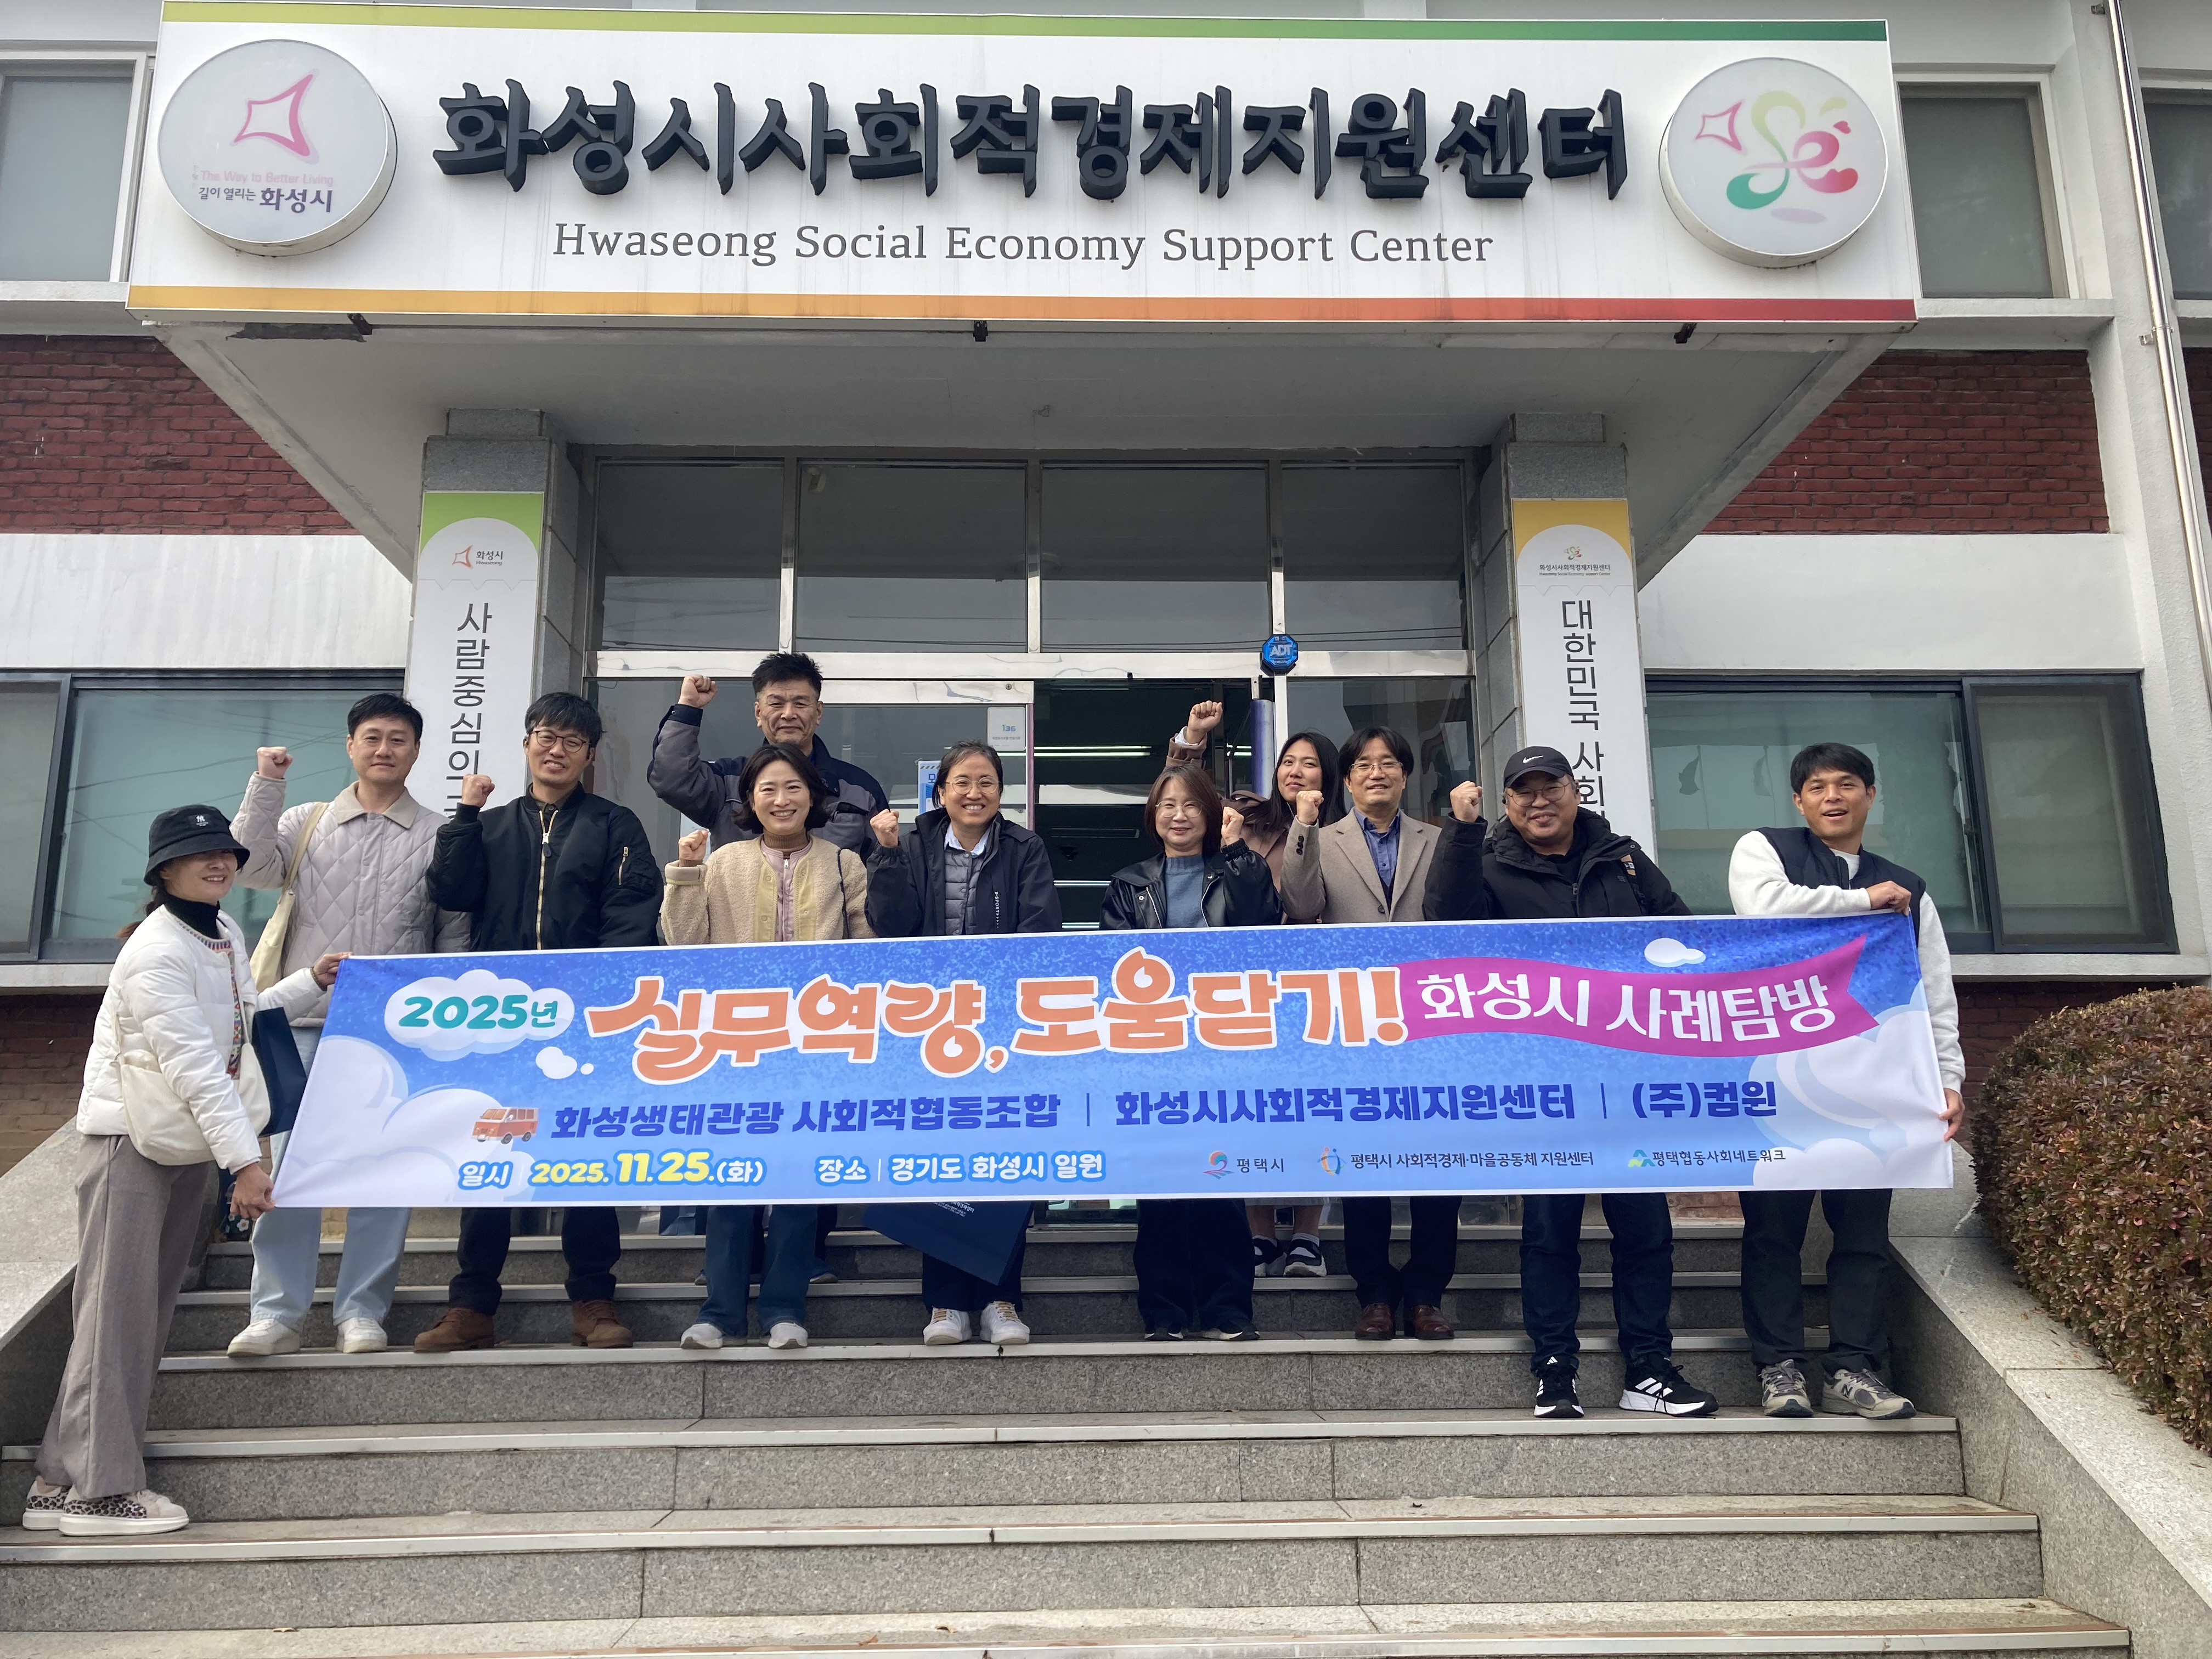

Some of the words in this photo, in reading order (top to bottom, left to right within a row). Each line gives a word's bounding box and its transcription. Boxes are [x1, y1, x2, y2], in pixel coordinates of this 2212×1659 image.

[432, 78, 1628, 200] 화성시사회적경제지원센터
[201, 170, 219, 181] The
[224, 171, 247, 184] Way
[252, 172, 261, 183] to
[266, 172, 300, 184] Better
[303, 173, 334, 187] Living
[199, 187, 220, 200] 길이
[223, 188, 256, 201] 열리는
[259, 188, 332, 213] 화성시
[552, 223, 777, 267] Hwaseong
[794, 224, 927, 261] Social
[946, 227, 1146, 270] Economy
[1163, 228, 1334, 270] Support
[1350, 229, 1493, 263] Center
[476, 551, 504, 561] 화성시
[1269, 644, 1293, 657] ADT
[1561, 600, 1600, 731] 대한민국
[1572, 741, 1605, 819] 사회
[398, 994, 558, 1029] 2025년
[1417, 972, 1590, 1028] 화성시
[1606, 974, 1829, 1043] 사례탐방
[550, 1101, 784, 1138] 화성생태관광
[792, 1093, 1060, 1133] 사회적협동조합
[1115, 1082, 1576, 1126] 화성시사회적경제지원센터
[1632, 1081, 1778, 1119] (주)컴윈
[818, 1159, 867, 1183] 장소
[892, 1156, 962, 1182] 경기도
[972, 1155, 1044, 1180] 화성시
[1054, 1153, 1103, 1178] 일원
[1351, 1153, 1393, 1169] 평택시
[1541, 1150, 1594, 1167] 지원센터
[1652, 1149, 1786, 1167] 평택협동사회네트워크
[462, 1165, 510, 1187] 일시
